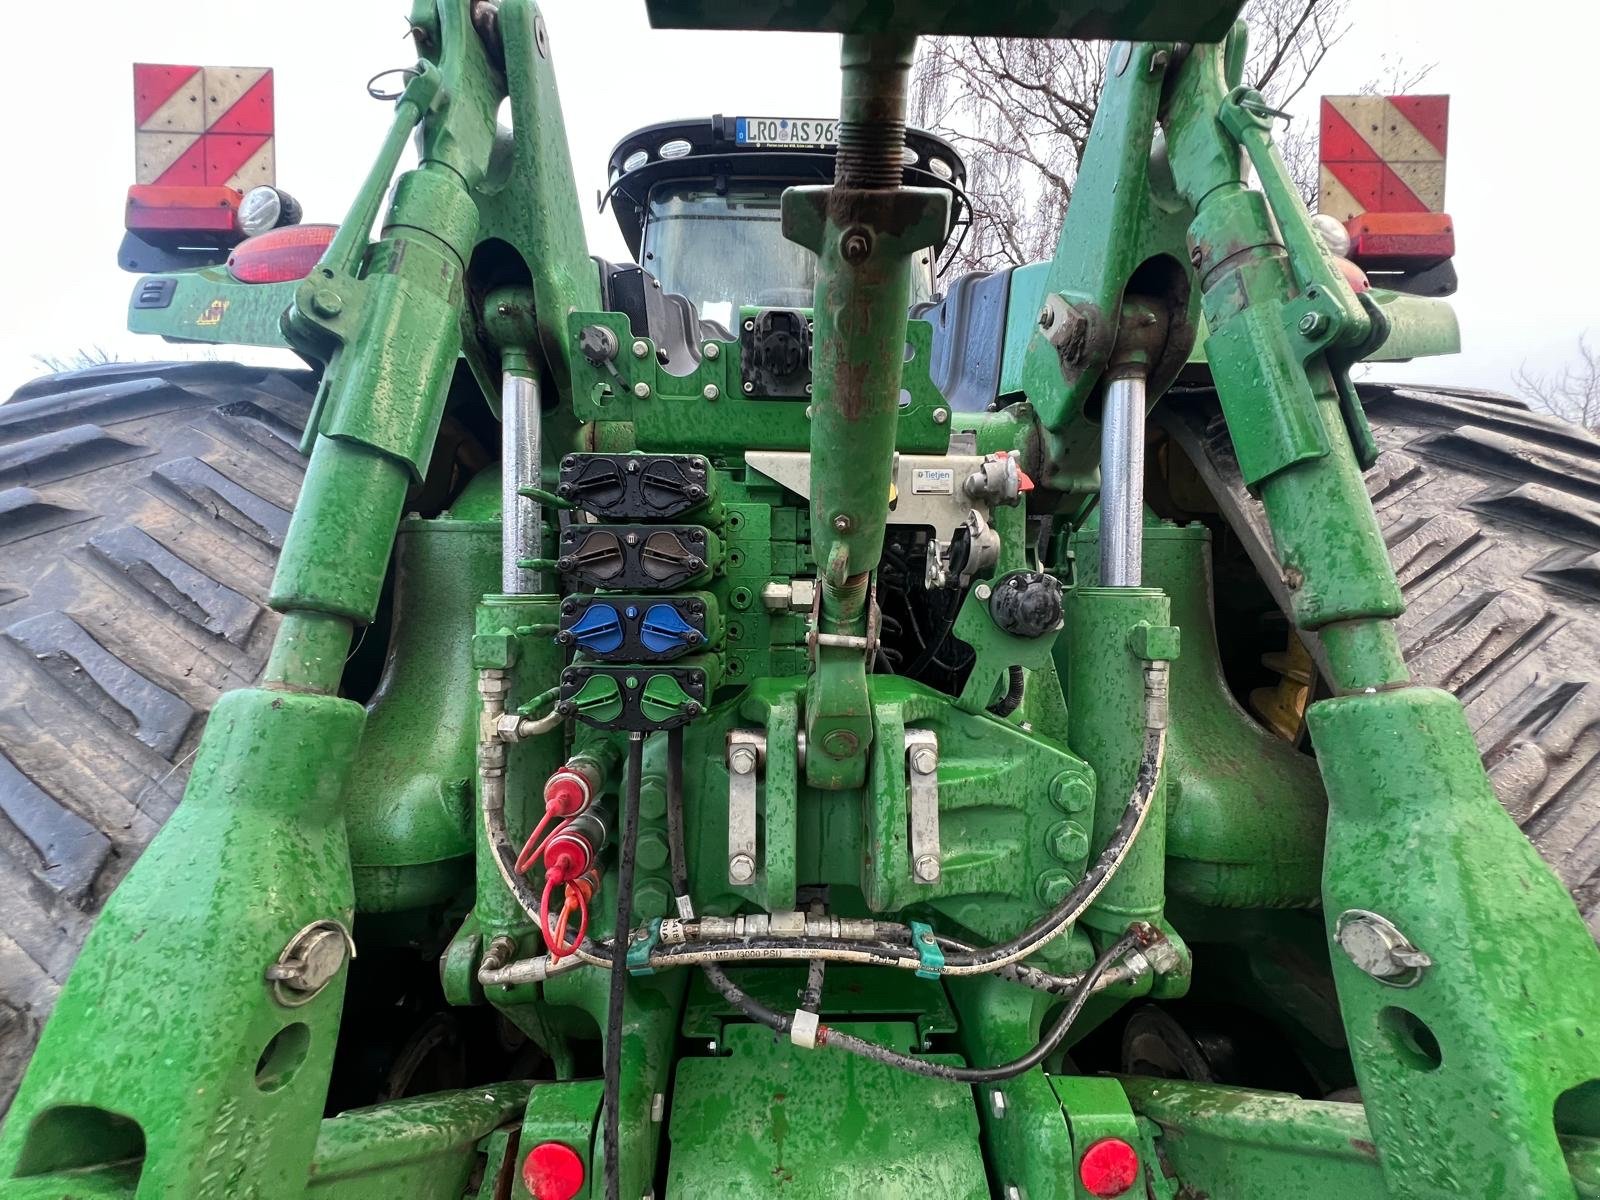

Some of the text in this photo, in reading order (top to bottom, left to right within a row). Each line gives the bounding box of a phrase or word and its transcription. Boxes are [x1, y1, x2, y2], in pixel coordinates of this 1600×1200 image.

[747, 121, 777, 141] LRO
[790, 122, 810, 141] AS
[925, 470, 950, 480] Tietjen
[702, 952, 713, 960] 21
[736, 950, 762, 959] (3000
[763, 949, 783, 958] PSI)
